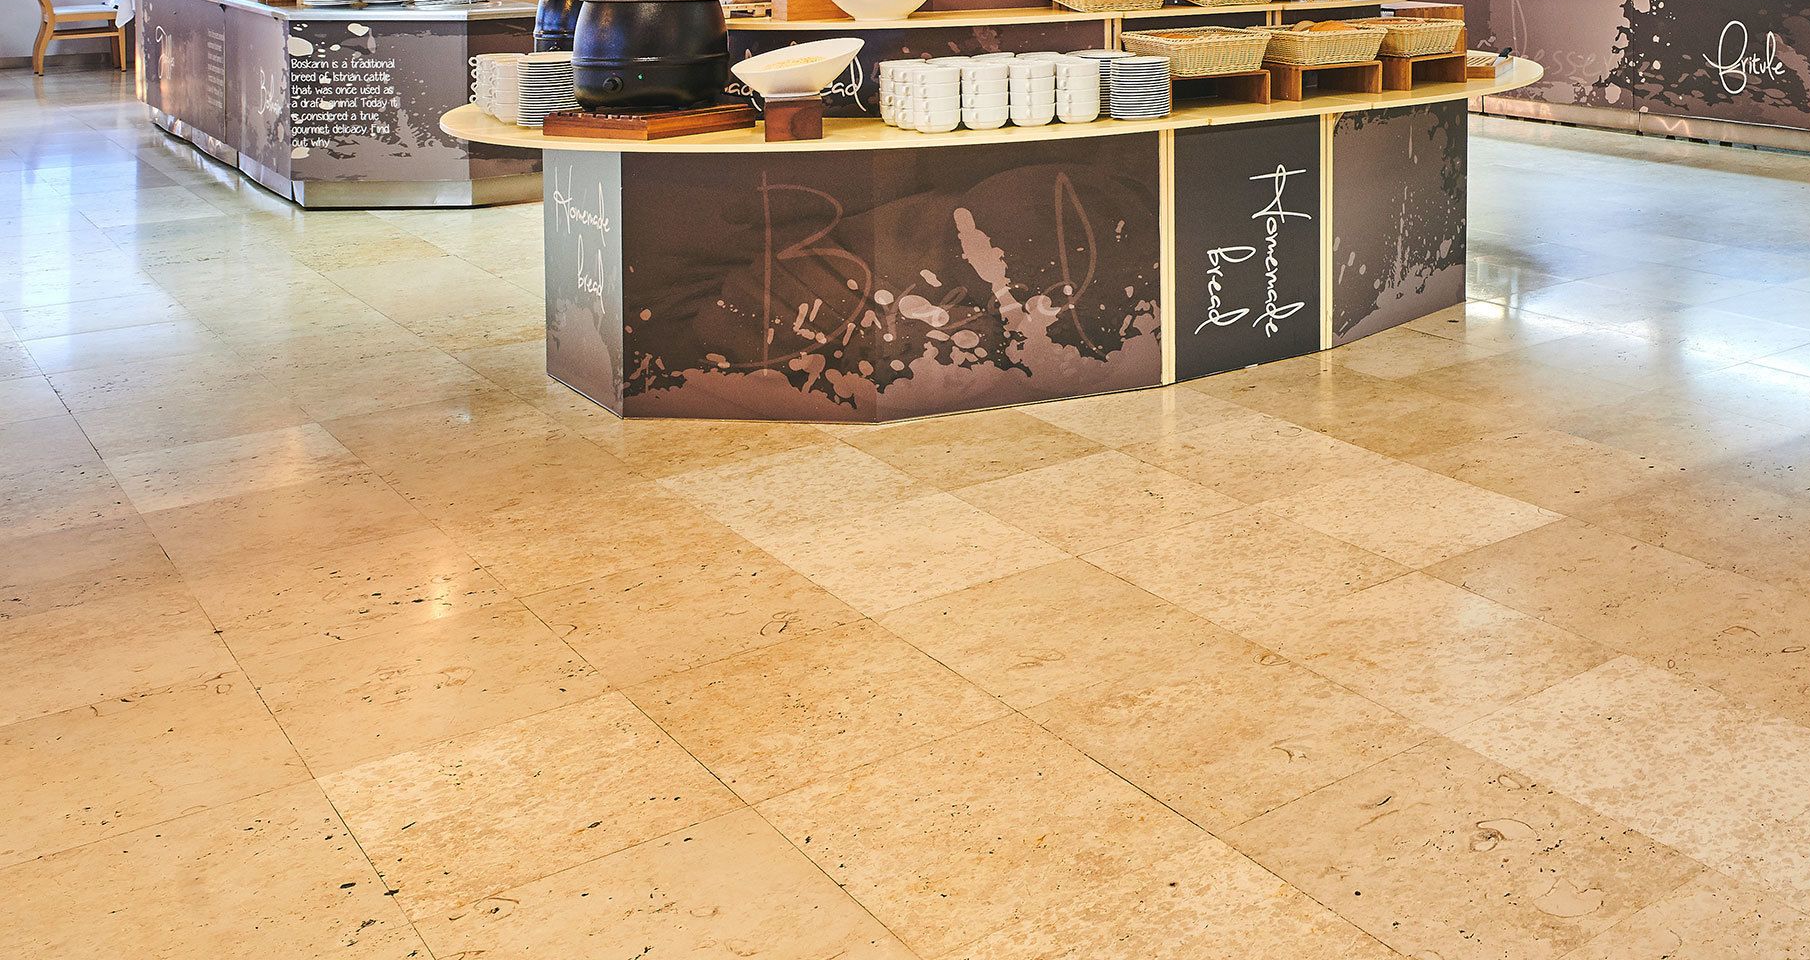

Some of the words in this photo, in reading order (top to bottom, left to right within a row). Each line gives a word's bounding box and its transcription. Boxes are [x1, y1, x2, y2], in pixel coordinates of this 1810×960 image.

[1702, 20, 1785, 94] Fritule
[332, 60, 339, 69] is
[341, 60, 348, 69] a
[351, 58, 395, 69] traditional
[291, 72, 316, 82] breed
[319, 72, 331, 82] of
[333, 72, 361, 82] Istrian
[363, 72, 391, 82] cattle
[291, 85, 312, 95] that
[315, 87, 333, 95] was
[335, 86, 357, 95] once
[360, 85, 380, 95] used
[383, 86, 394, 95] as
[291, 99, 298, 108] a
[360, 97, 388, 109] Today
[389, 98, 398, 108] it
[301, 112, 348, 121] considered
[350, 113, 357, 121] a
[360, 111, 379, 121] true
[291, 124, 330, 136] gourmet
[371, 124, 390, 134] Find
[292, 138, 309, 147] out
[553, 165, 610, 247] Homemade
[1249, 163, 1312, 339] Homemade
[577, 234, 606, 314] bread
[1194, 245, 1256, 335] bread
